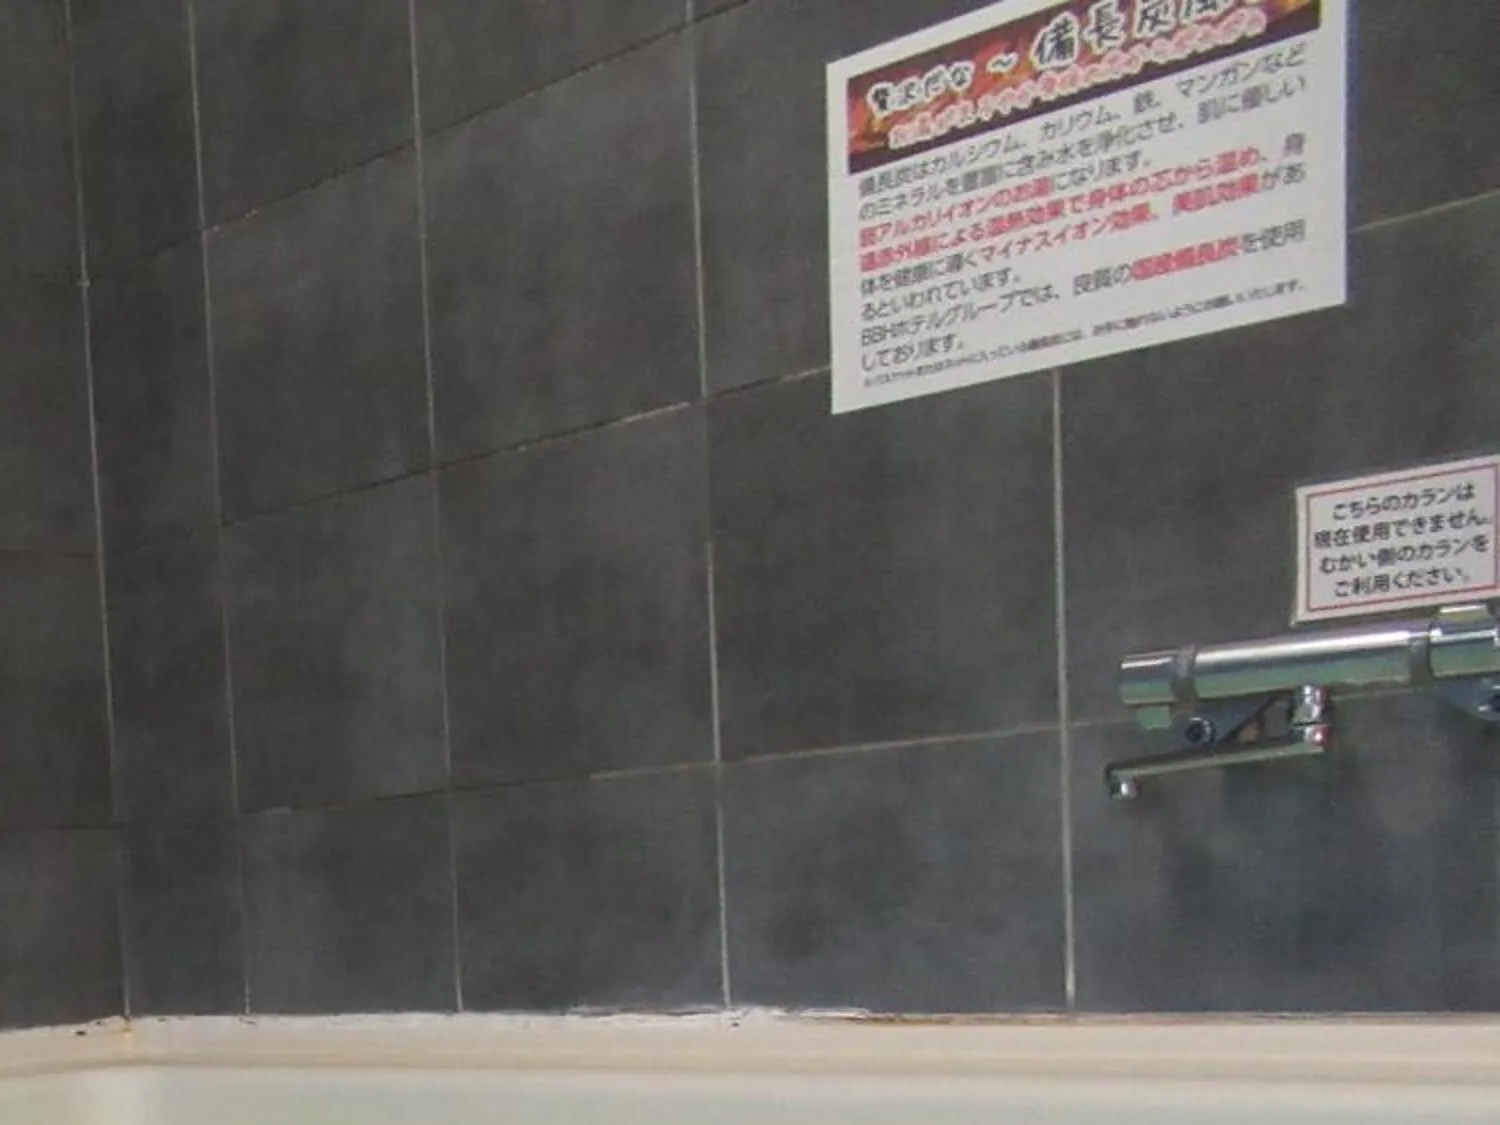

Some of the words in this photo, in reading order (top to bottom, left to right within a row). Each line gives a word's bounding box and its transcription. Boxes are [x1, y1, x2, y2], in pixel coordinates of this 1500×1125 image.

[1333, 482, 1475, 520] こちらのカランは
